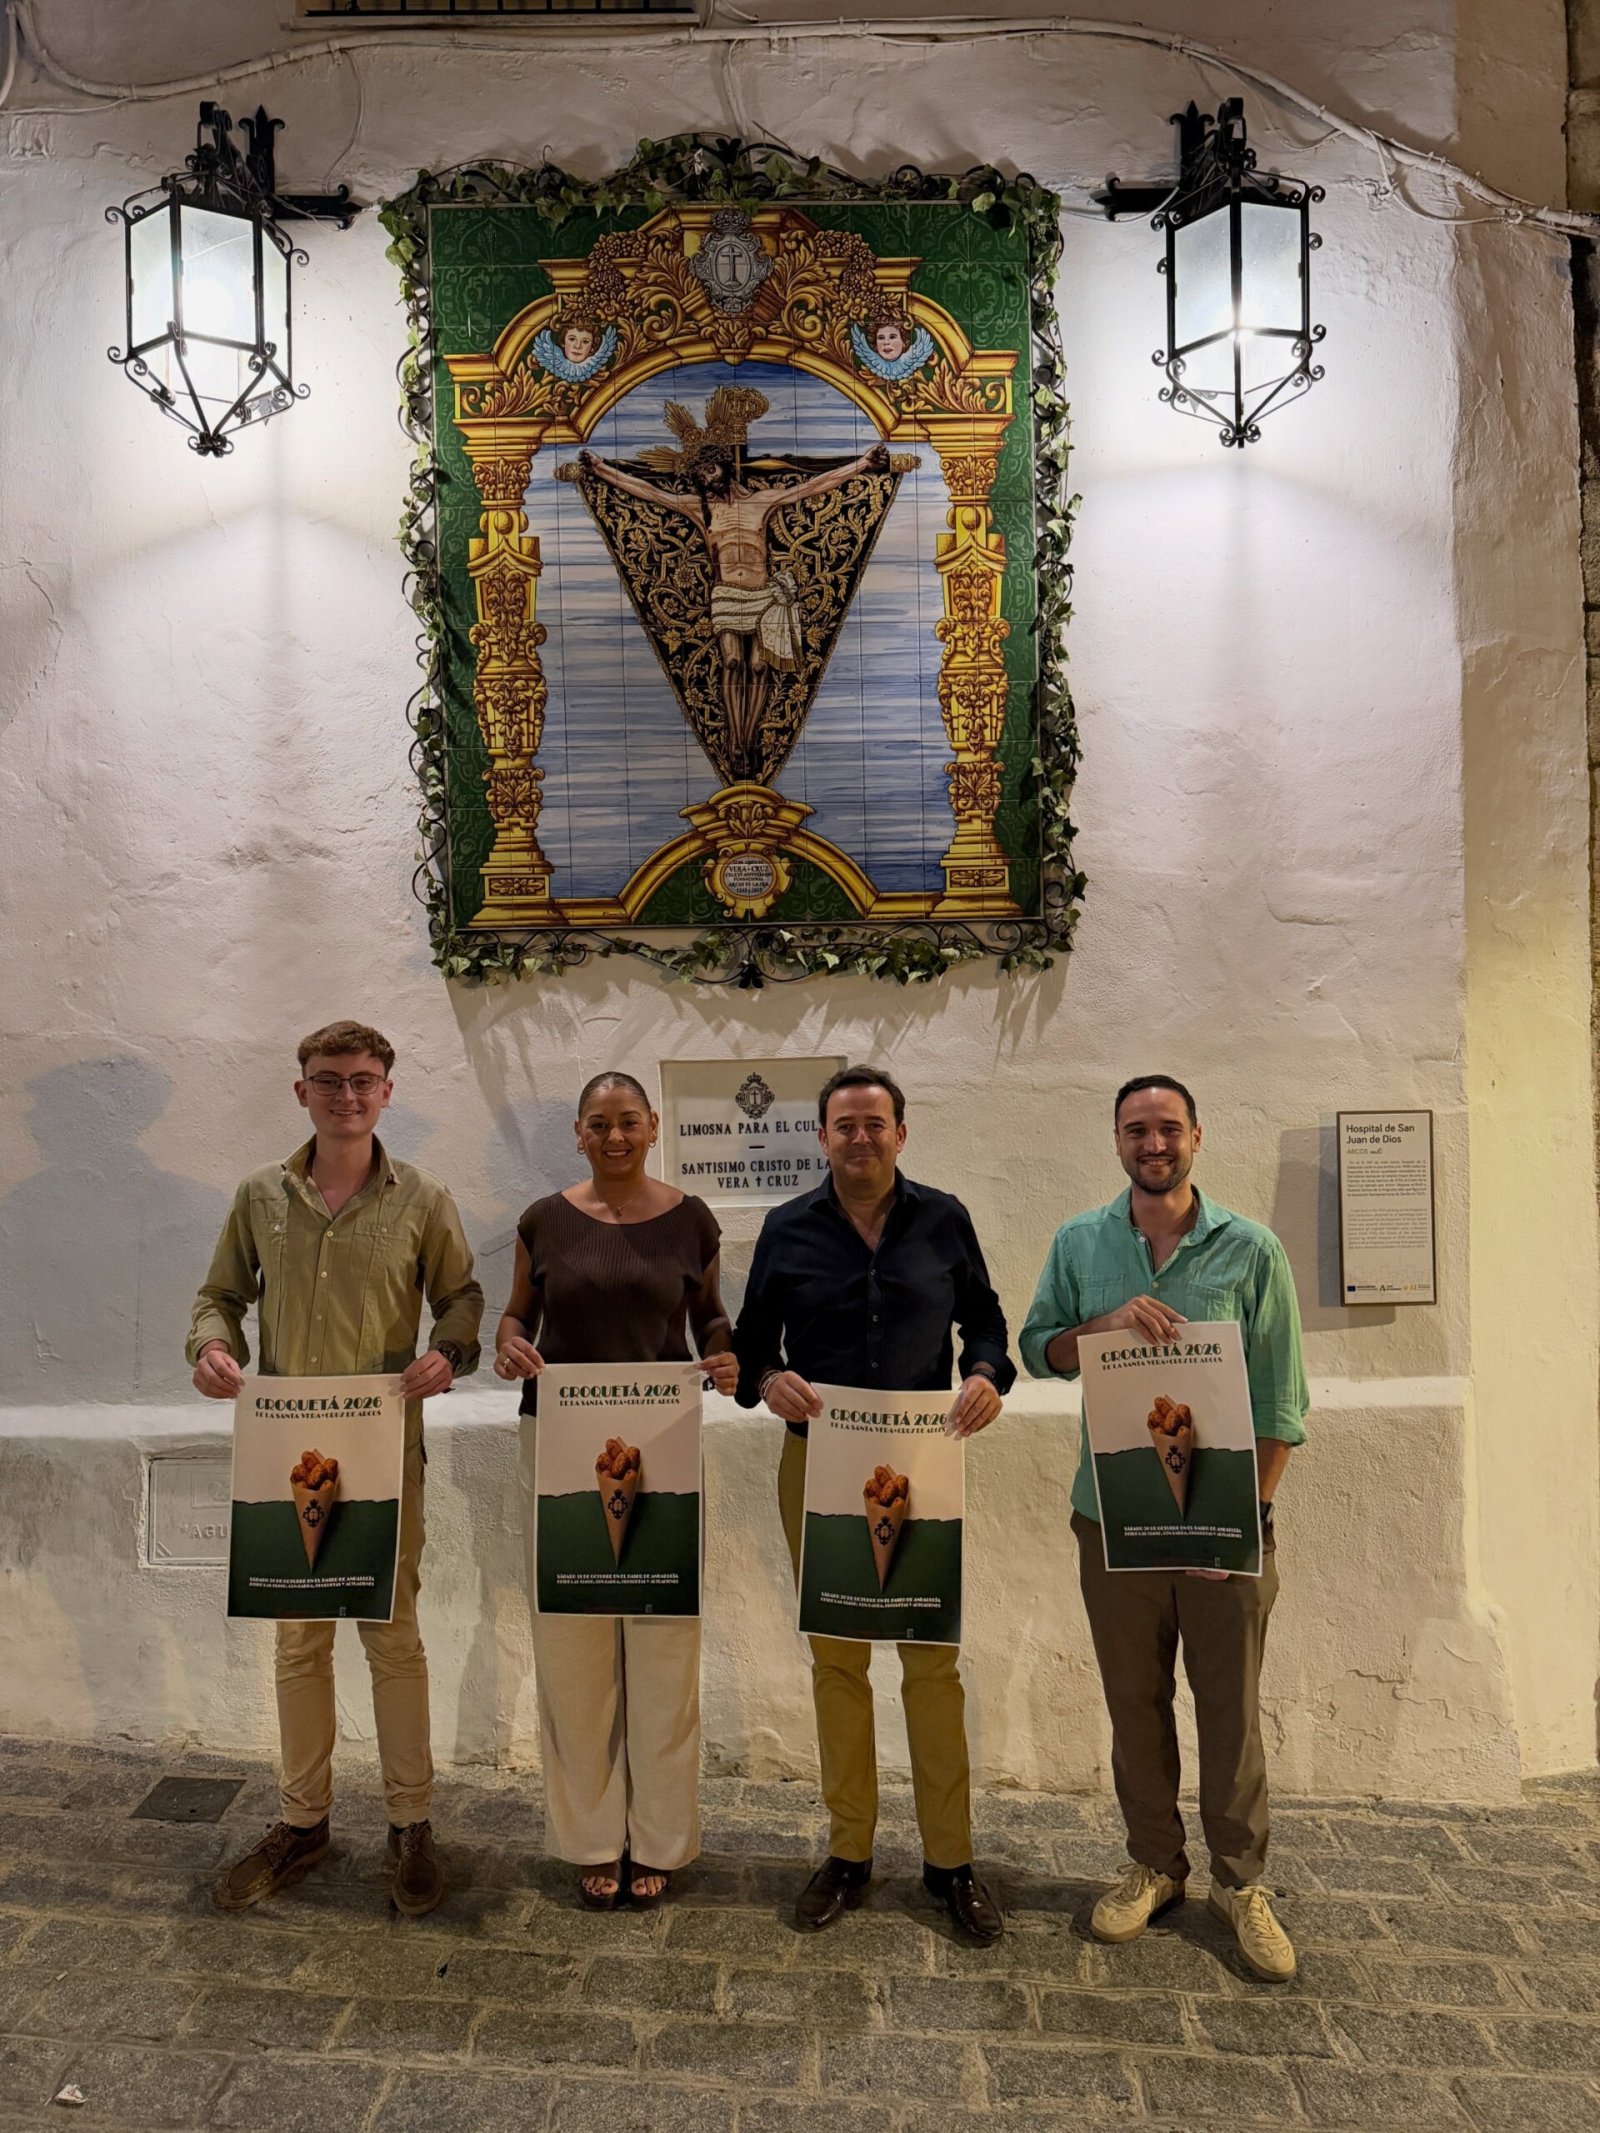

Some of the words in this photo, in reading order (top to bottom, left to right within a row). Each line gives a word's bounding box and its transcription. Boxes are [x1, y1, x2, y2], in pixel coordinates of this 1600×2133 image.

[680, 1123, 731, 1137] LIMOSNA
[738, 1121, 769, 1134] PARA
[776, 1121, 789, 1132] EL
[1346, 1124, 1382, 1134] Hospital
[1385, 1124, 1395, 1132] de
[1398, 1124, 1414, 1132] San
[1347, 1136, 1367, 1144] Juan
[1370, 1135, 1380, 1143] de
[1382, 1135, 1402, 1143] Dios
[682, 1160, 745, 1175] SANTISIMO
[750, 1159, 791, 1172] CRISTO
[796, 1159, 811, 1171] DE
[717, 1177, 750, 1188] VERA
[767, 1175, 798, 1187] CRUZ
[1101, 1343, 1181, 1363] CROQUETÁ
[1185, 1343, 1222, 1356] 2026
[559, 1382, 640, 1398] CROQUETÁ
[644, 1385, 680, 1397] 2026
[255, 1396, 339, 1411] CROQUETÁ
[344, 1396, 382, 1409] 2026
[830, 1408, 911, 1425] CROQUETÁ
[914, 1413, 947, 1425] 2026
